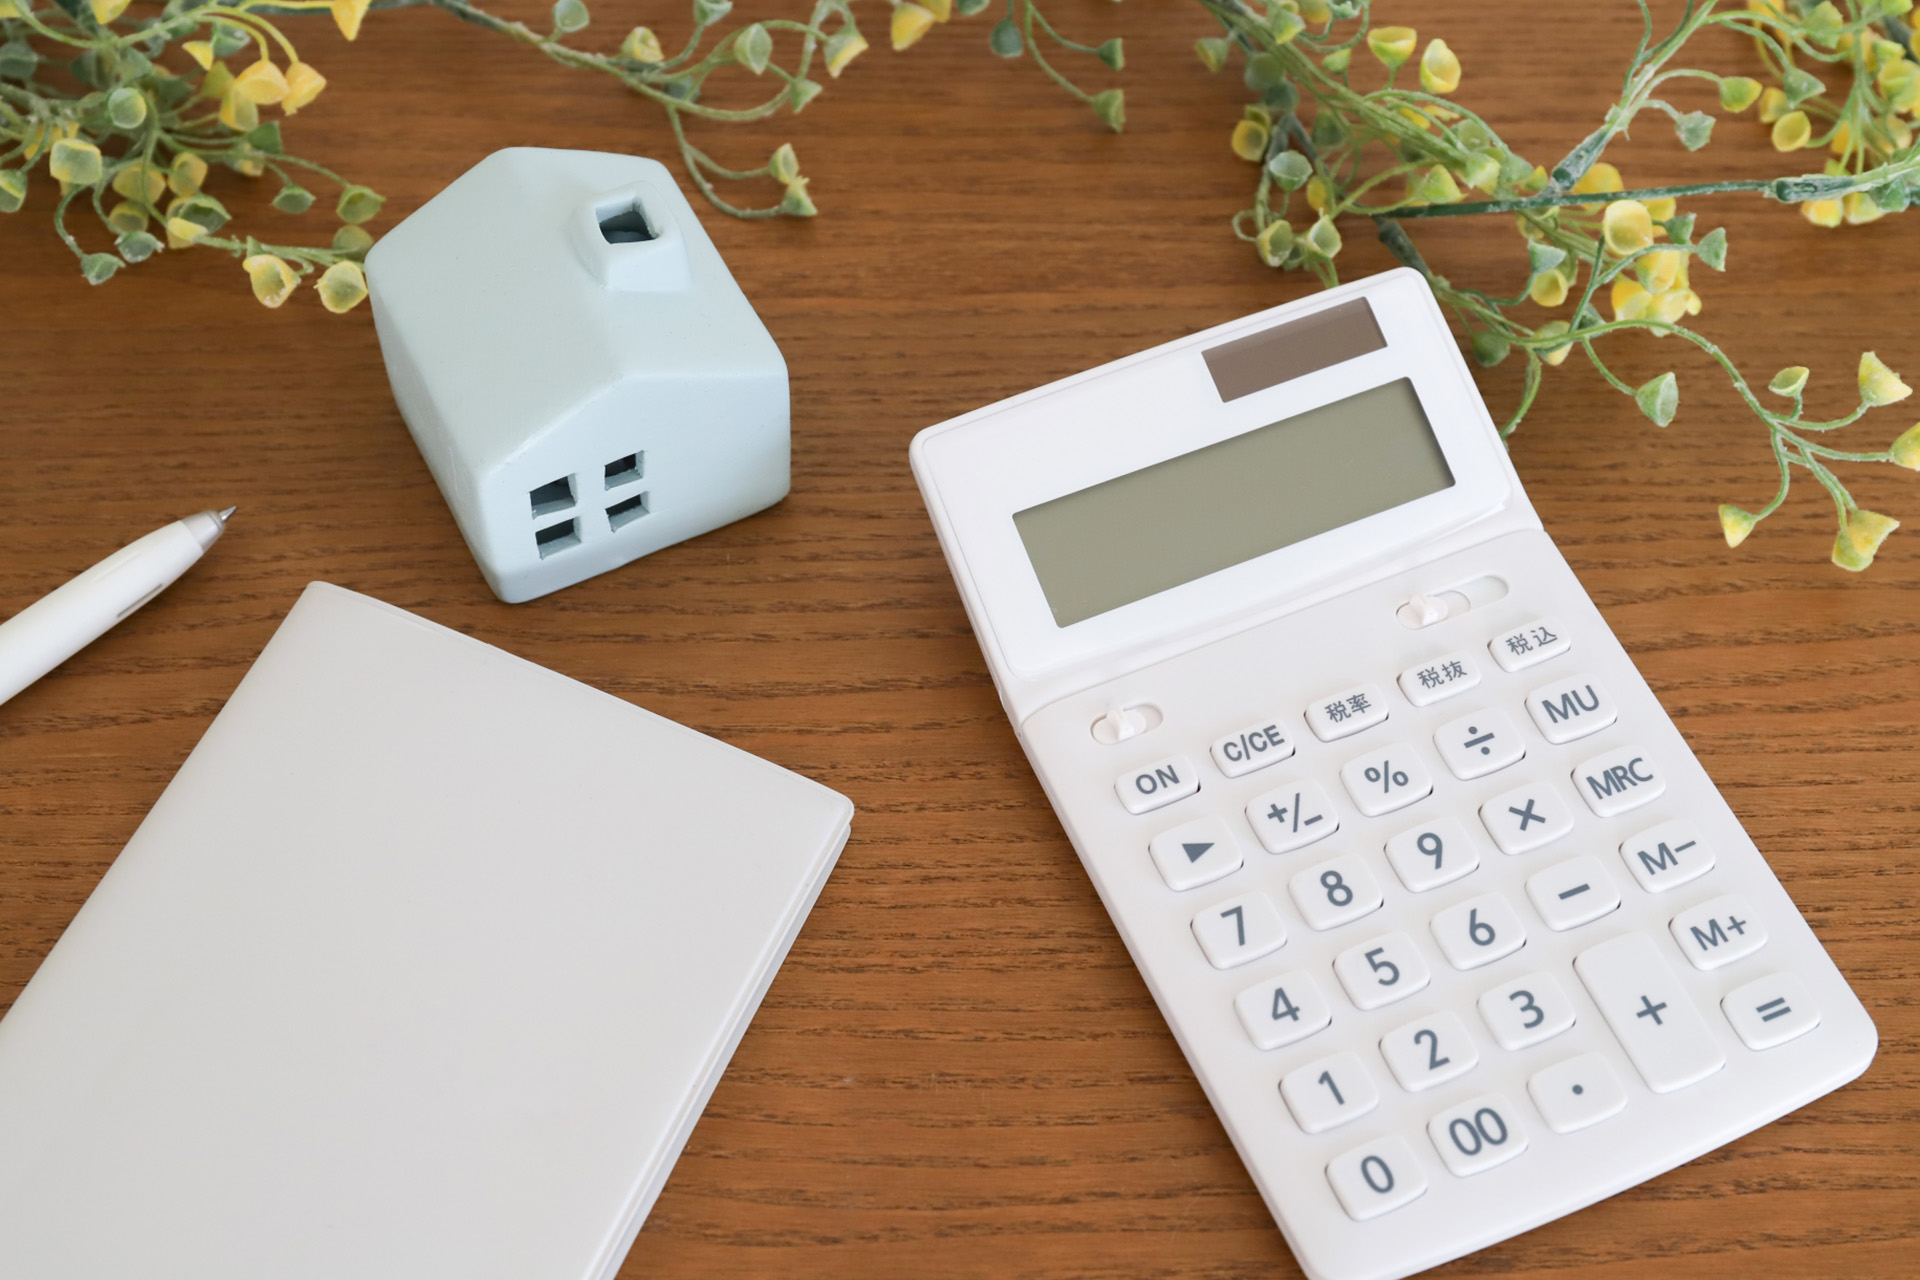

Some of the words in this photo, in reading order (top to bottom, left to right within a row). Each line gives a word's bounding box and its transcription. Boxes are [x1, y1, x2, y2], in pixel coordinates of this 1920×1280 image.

[1505, 626, 1558, 656] 税込
[1416, 660, 1468, 689] 税抜
[1324, 693, 1372, 723] 税率
[1541, 684, 1600, 724] MU
[1223, 724, 1286, 763] C/CE
[1135, 764, 1180, 795] ON
[1363, 759, 1409, 794] %
[1585, 757, 1654, 800] MRC
[1416, 832, 1443, 870] 9
[1319, 870, 1354, 907] 8
[1220, 905, 1246, 947] 7
[1468, 908, 1496, 947] 6
[1689, 915, 1747, 951] M+
[1364, 946, 1400, 986] 5
[1271, 987, 1301, 1022] 4
[1508, 989, 1545, 1029] 3
[1636, 995, 1668, 1026] +
[1755, 997, 1792, 1023] =
[1413, 1029, 1451, 1071] 2
[1317, 1070, 1345, 1106] 1
[1448, 1107, 1509, 1157] 00
[1360, 1155, 1395, 1194] 0
